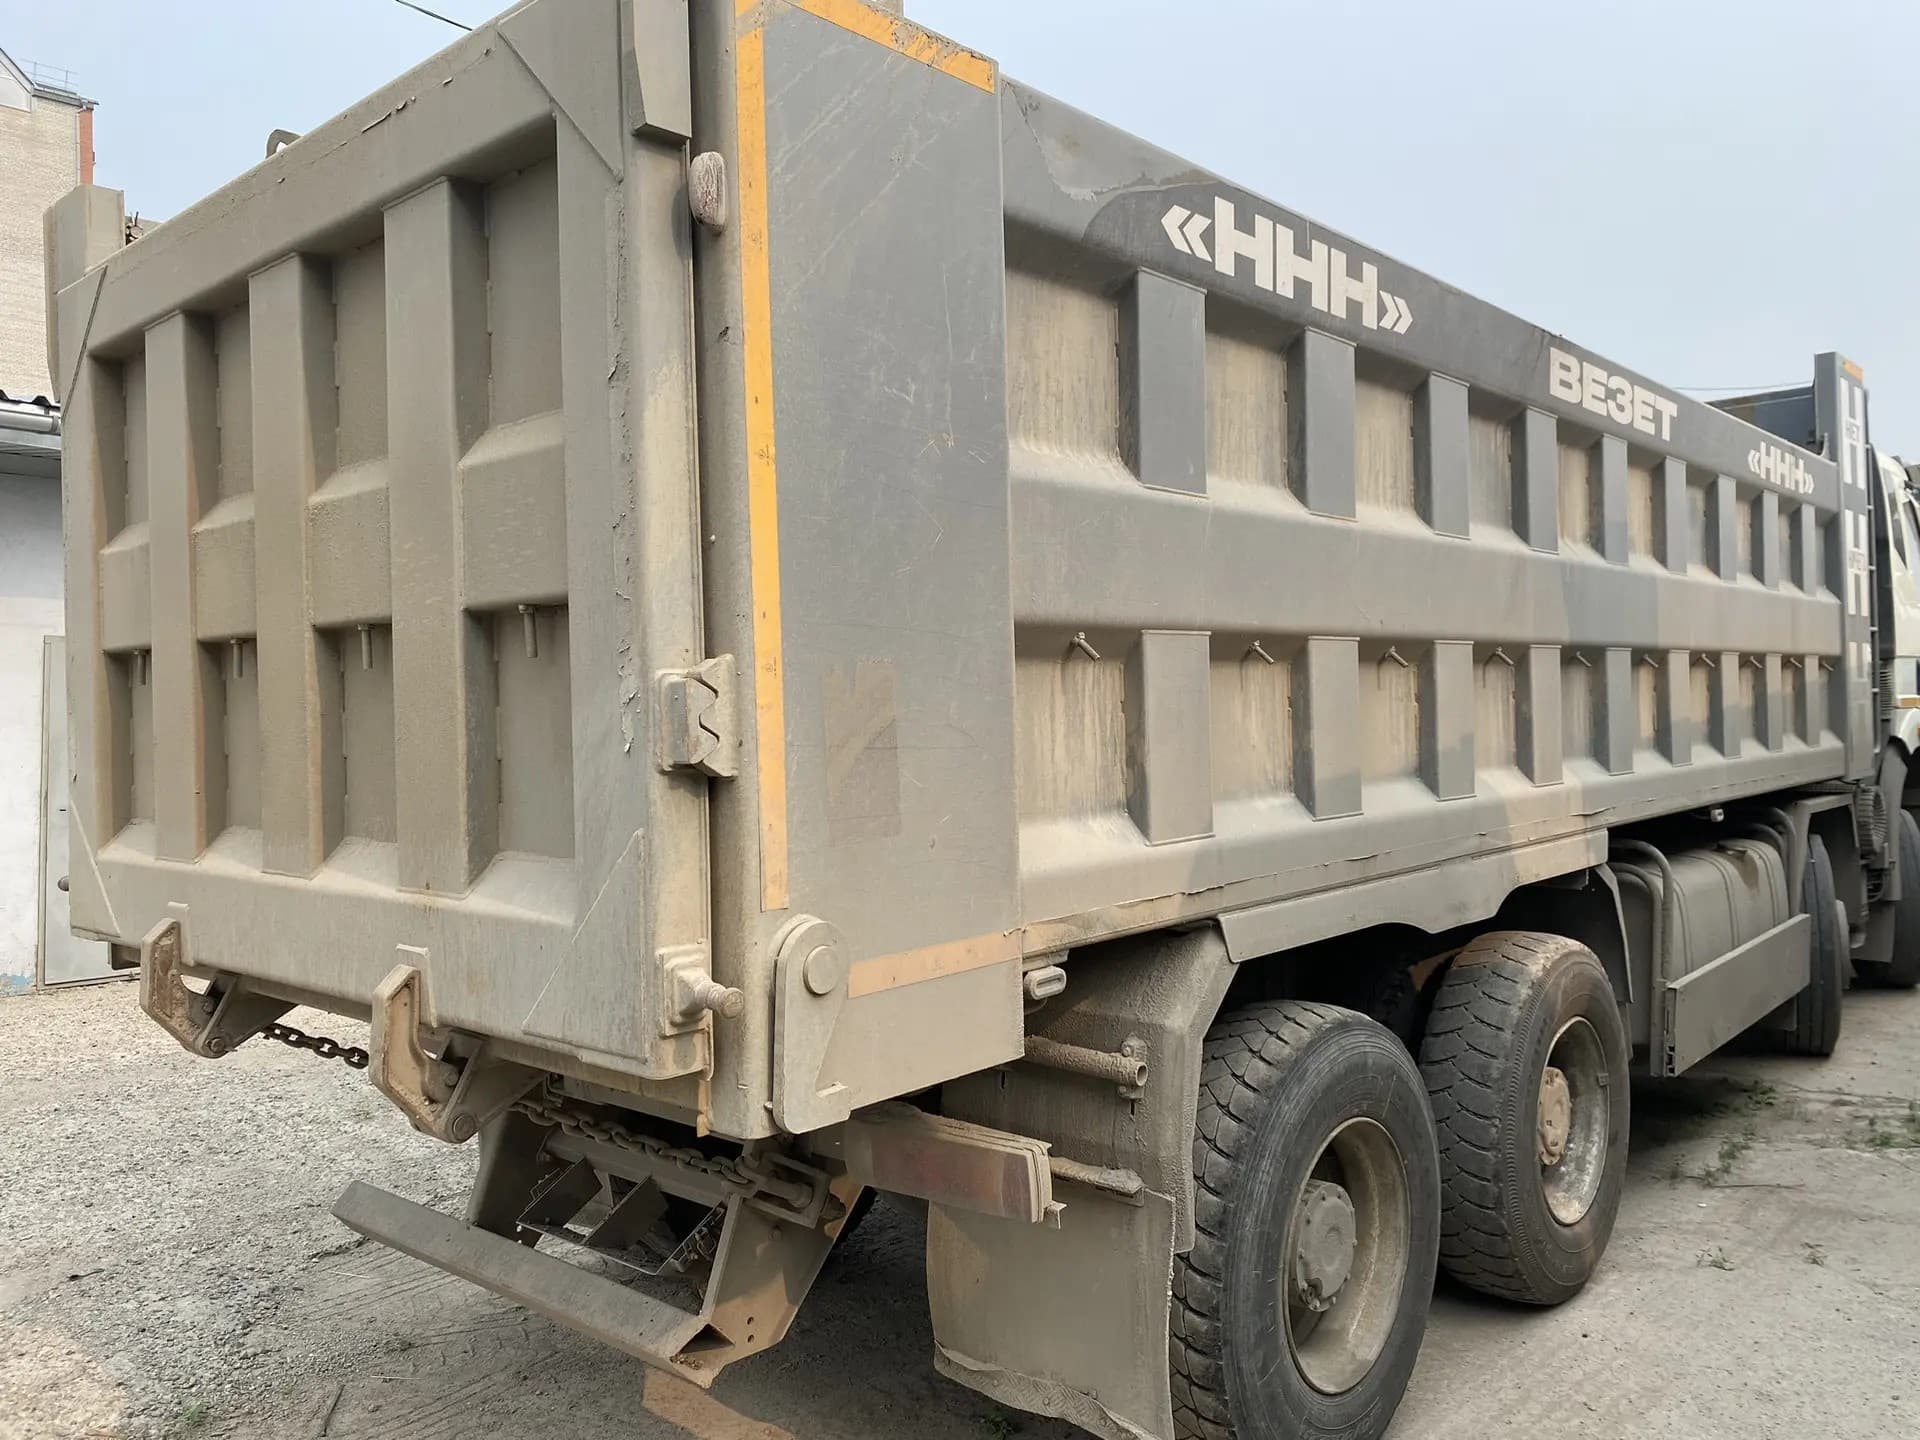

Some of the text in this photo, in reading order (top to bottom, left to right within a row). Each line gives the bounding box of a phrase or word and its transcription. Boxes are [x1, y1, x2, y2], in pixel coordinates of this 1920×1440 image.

[1160, 196, 1814, 494] «ННН» ВЕЗЕТ «ННН»
